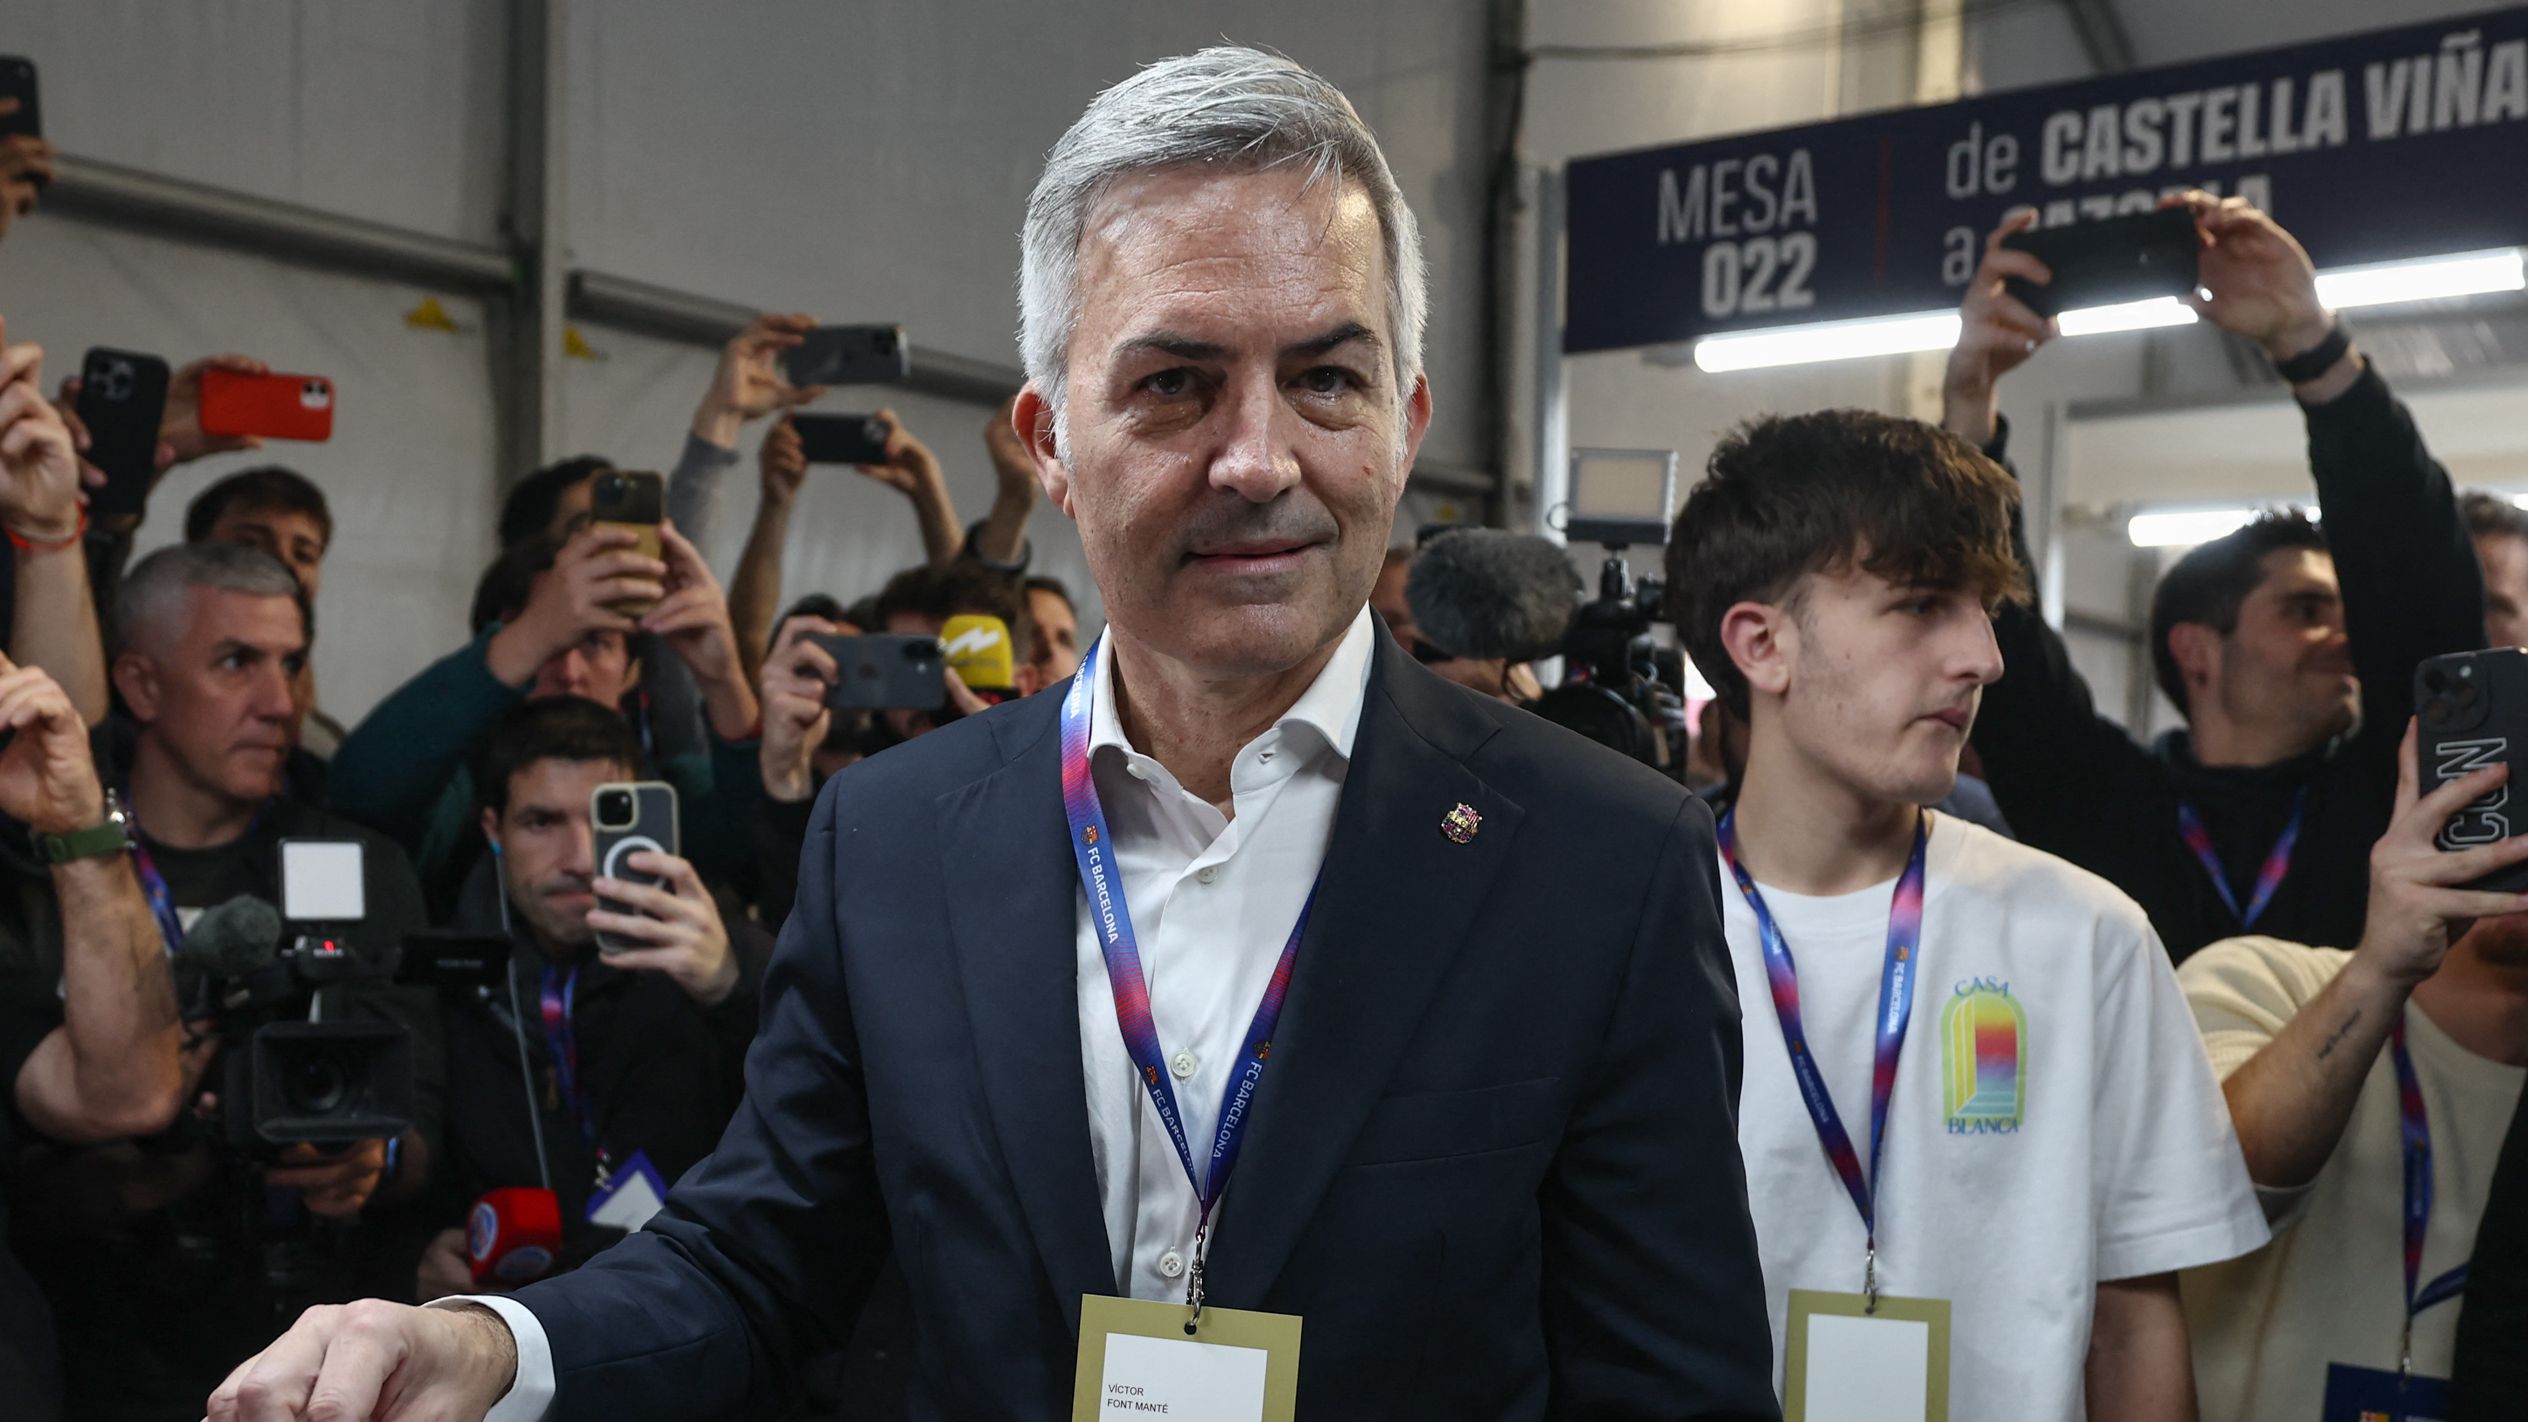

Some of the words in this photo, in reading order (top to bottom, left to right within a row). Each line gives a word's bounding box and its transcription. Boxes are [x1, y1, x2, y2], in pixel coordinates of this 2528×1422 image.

[1945, 122, 2019, 199] de
[2040, 68, 2348, 186] CASTELLA
[2363, 26, 2528, 142] VIÑA
[1657, 148, 1818, 244] MESA
[1942, 226, 1977, 286] a
[1702, 231, 1818, 318] 022
[1087, 847, 1101, 865] FC
[1092, 864, 1119, 944] BARCELONA
[1954, 975, 2010, 998] CASA
[1246, 1061, 1262, 1081] FC
[1152, 1088, 1167, 1107] FC
[1212, 1079, 1255, 1158] BARCELONA
[1947, 1116, 2020, 1136] BLANCA
[1108, 1384, 1144, 1397] VÍCTOR
[1107, 1398, 1133, 1409] FONT
[1135, 1401, 1169, 1414] MANTÉ
